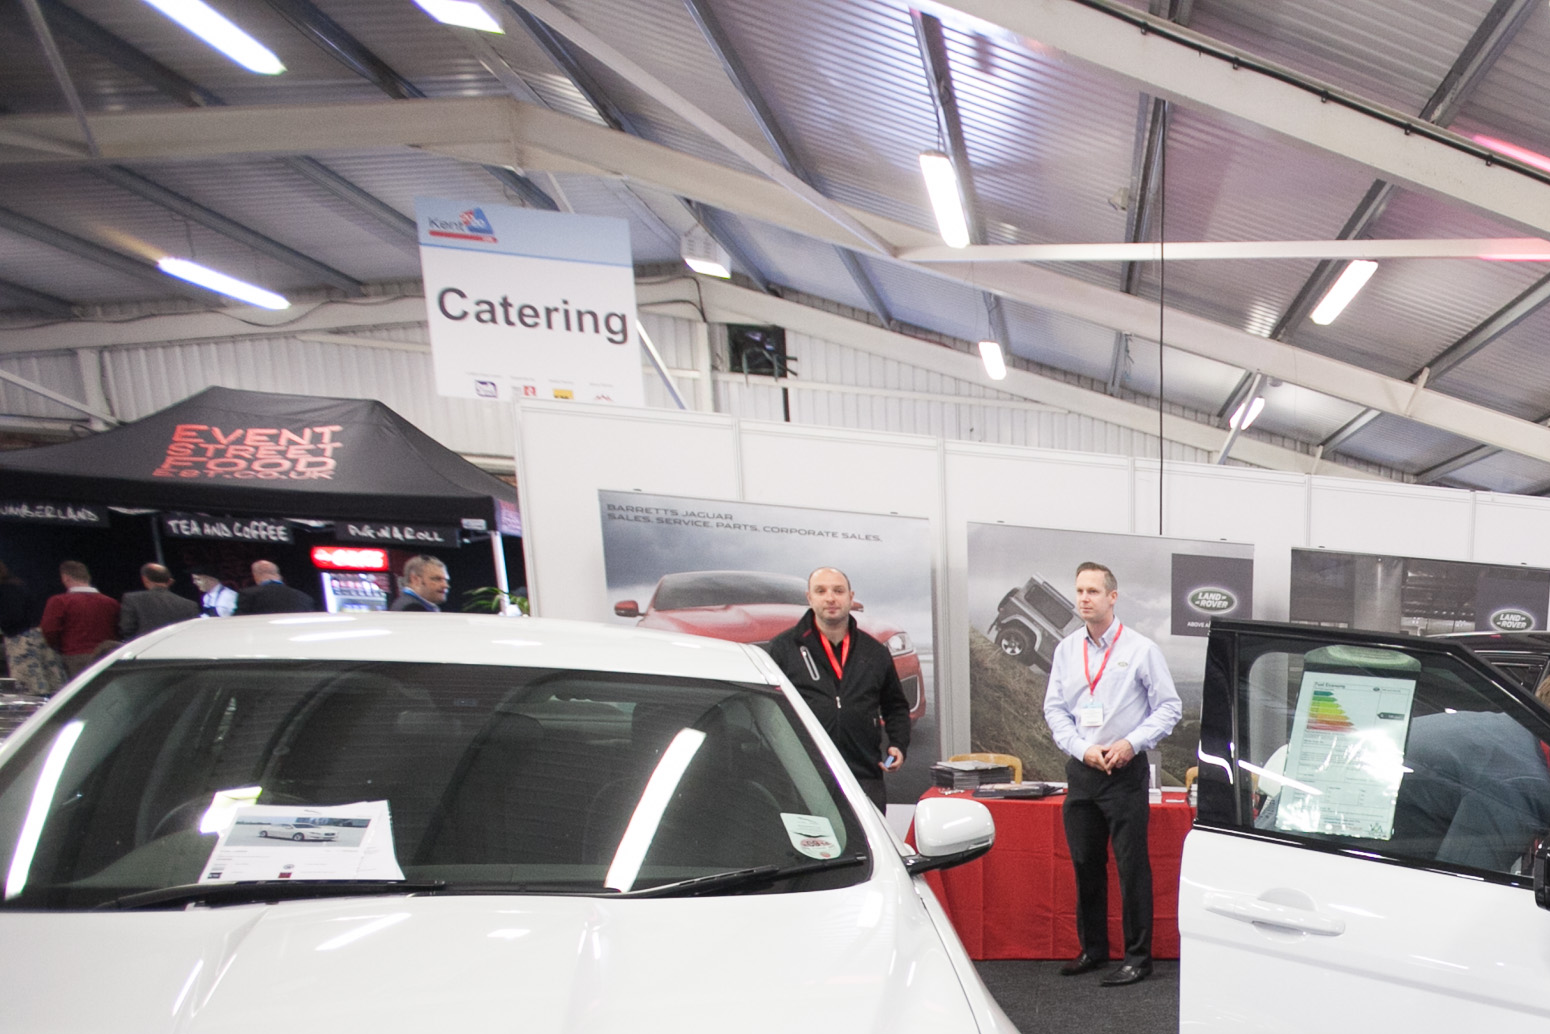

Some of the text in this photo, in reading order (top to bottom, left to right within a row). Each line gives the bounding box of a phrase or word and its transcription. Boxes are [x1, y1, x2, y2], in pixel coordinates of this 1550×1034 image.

[437, 287, 628, 345] Catering
[171, 424, 343, 446] EVENT
[166, 442, 343, 459] STREET
[160, 455, 337, 472] FOOD
[607, 504, 733, 521] BARRETTS JAGUAR
[167, 519, 290, 541] TEA AND COFFEE
[762, 525, 839, 538] CORPORATE
[841, 532, 883, 542] SALES.
[1198, 592, 1221, 600] LAND
[1200, 600, 1229, 608] ROVER
[1500, 613, 1521, 621] LAND
[1501, 621, 1527, 629] ROVER
